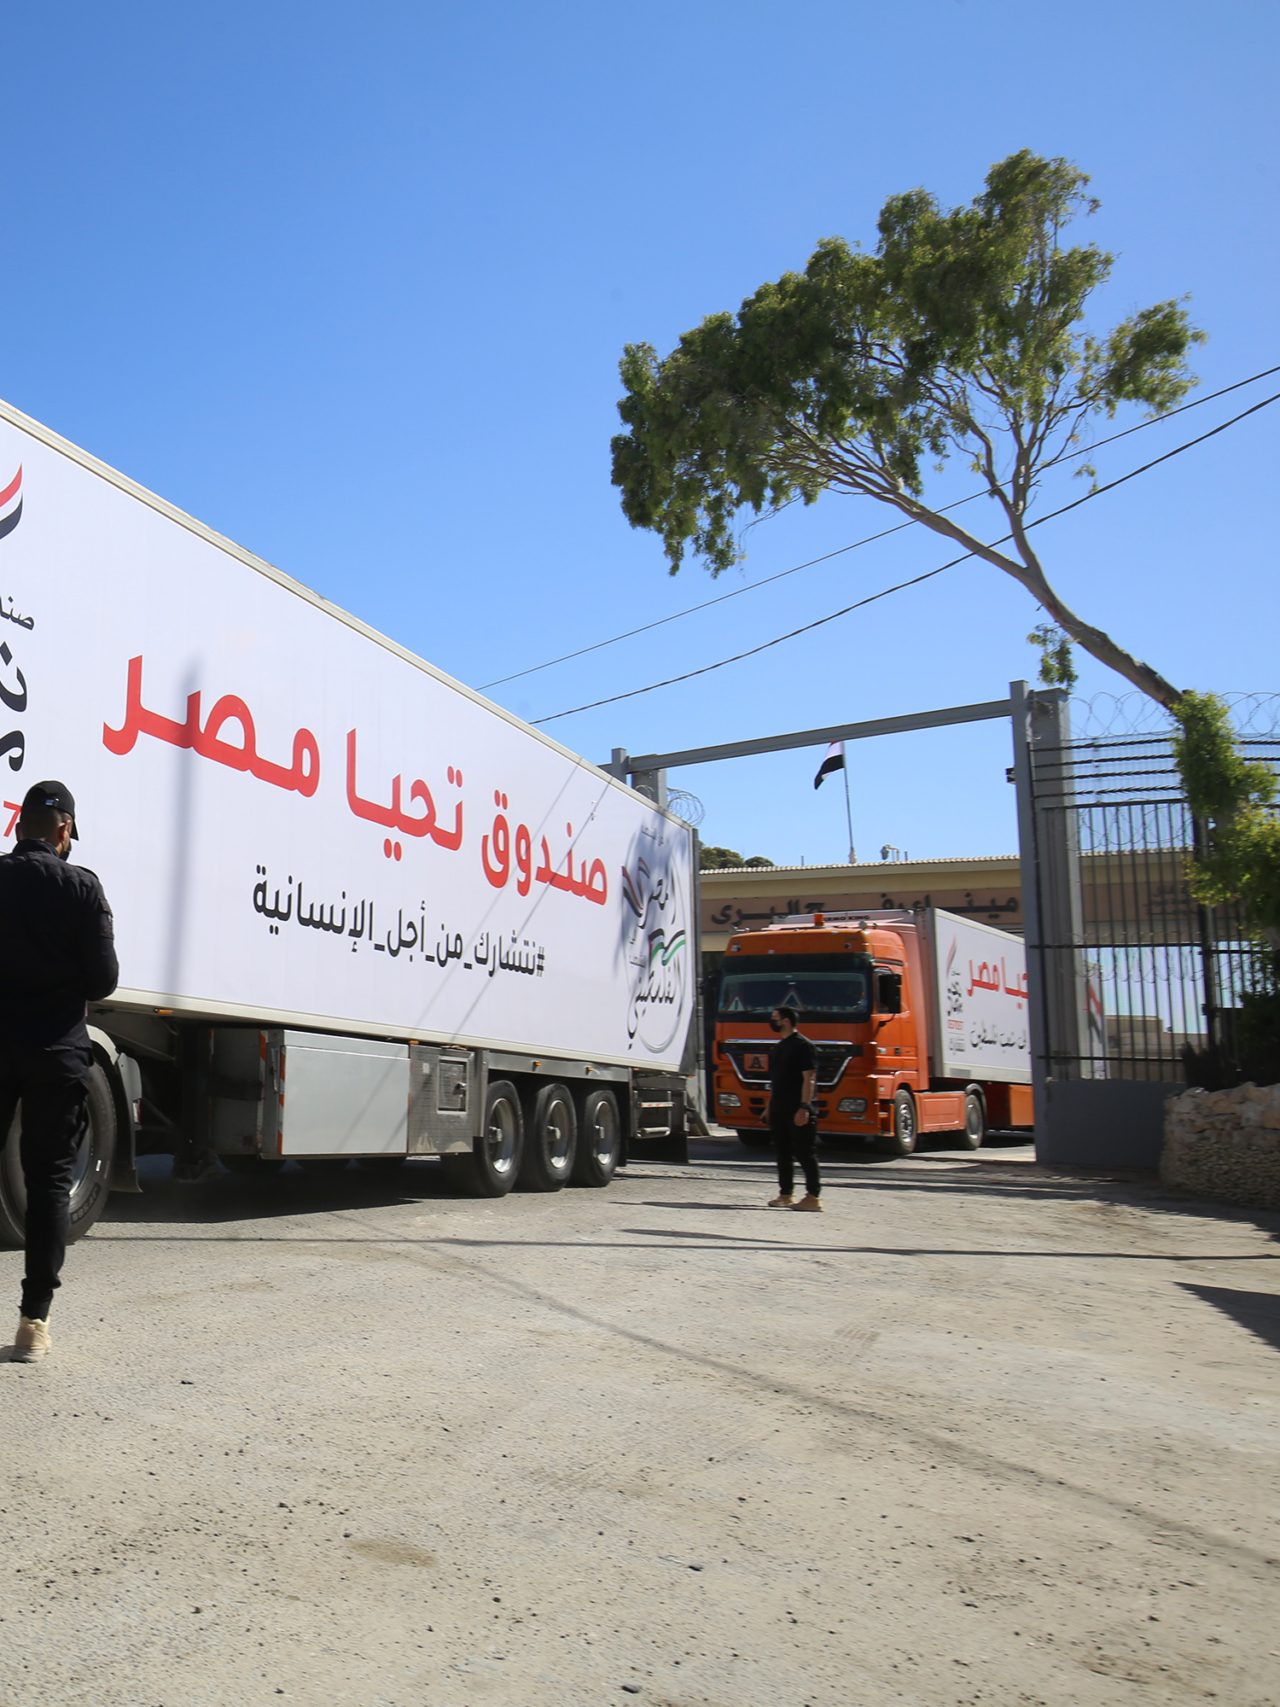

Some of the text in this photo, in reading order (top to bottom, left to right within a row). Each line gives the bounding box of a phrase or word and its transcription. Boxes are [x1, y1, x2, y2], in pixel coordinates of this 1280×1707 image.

[103, 654, 608, 906] صندوق تحيا مصر
